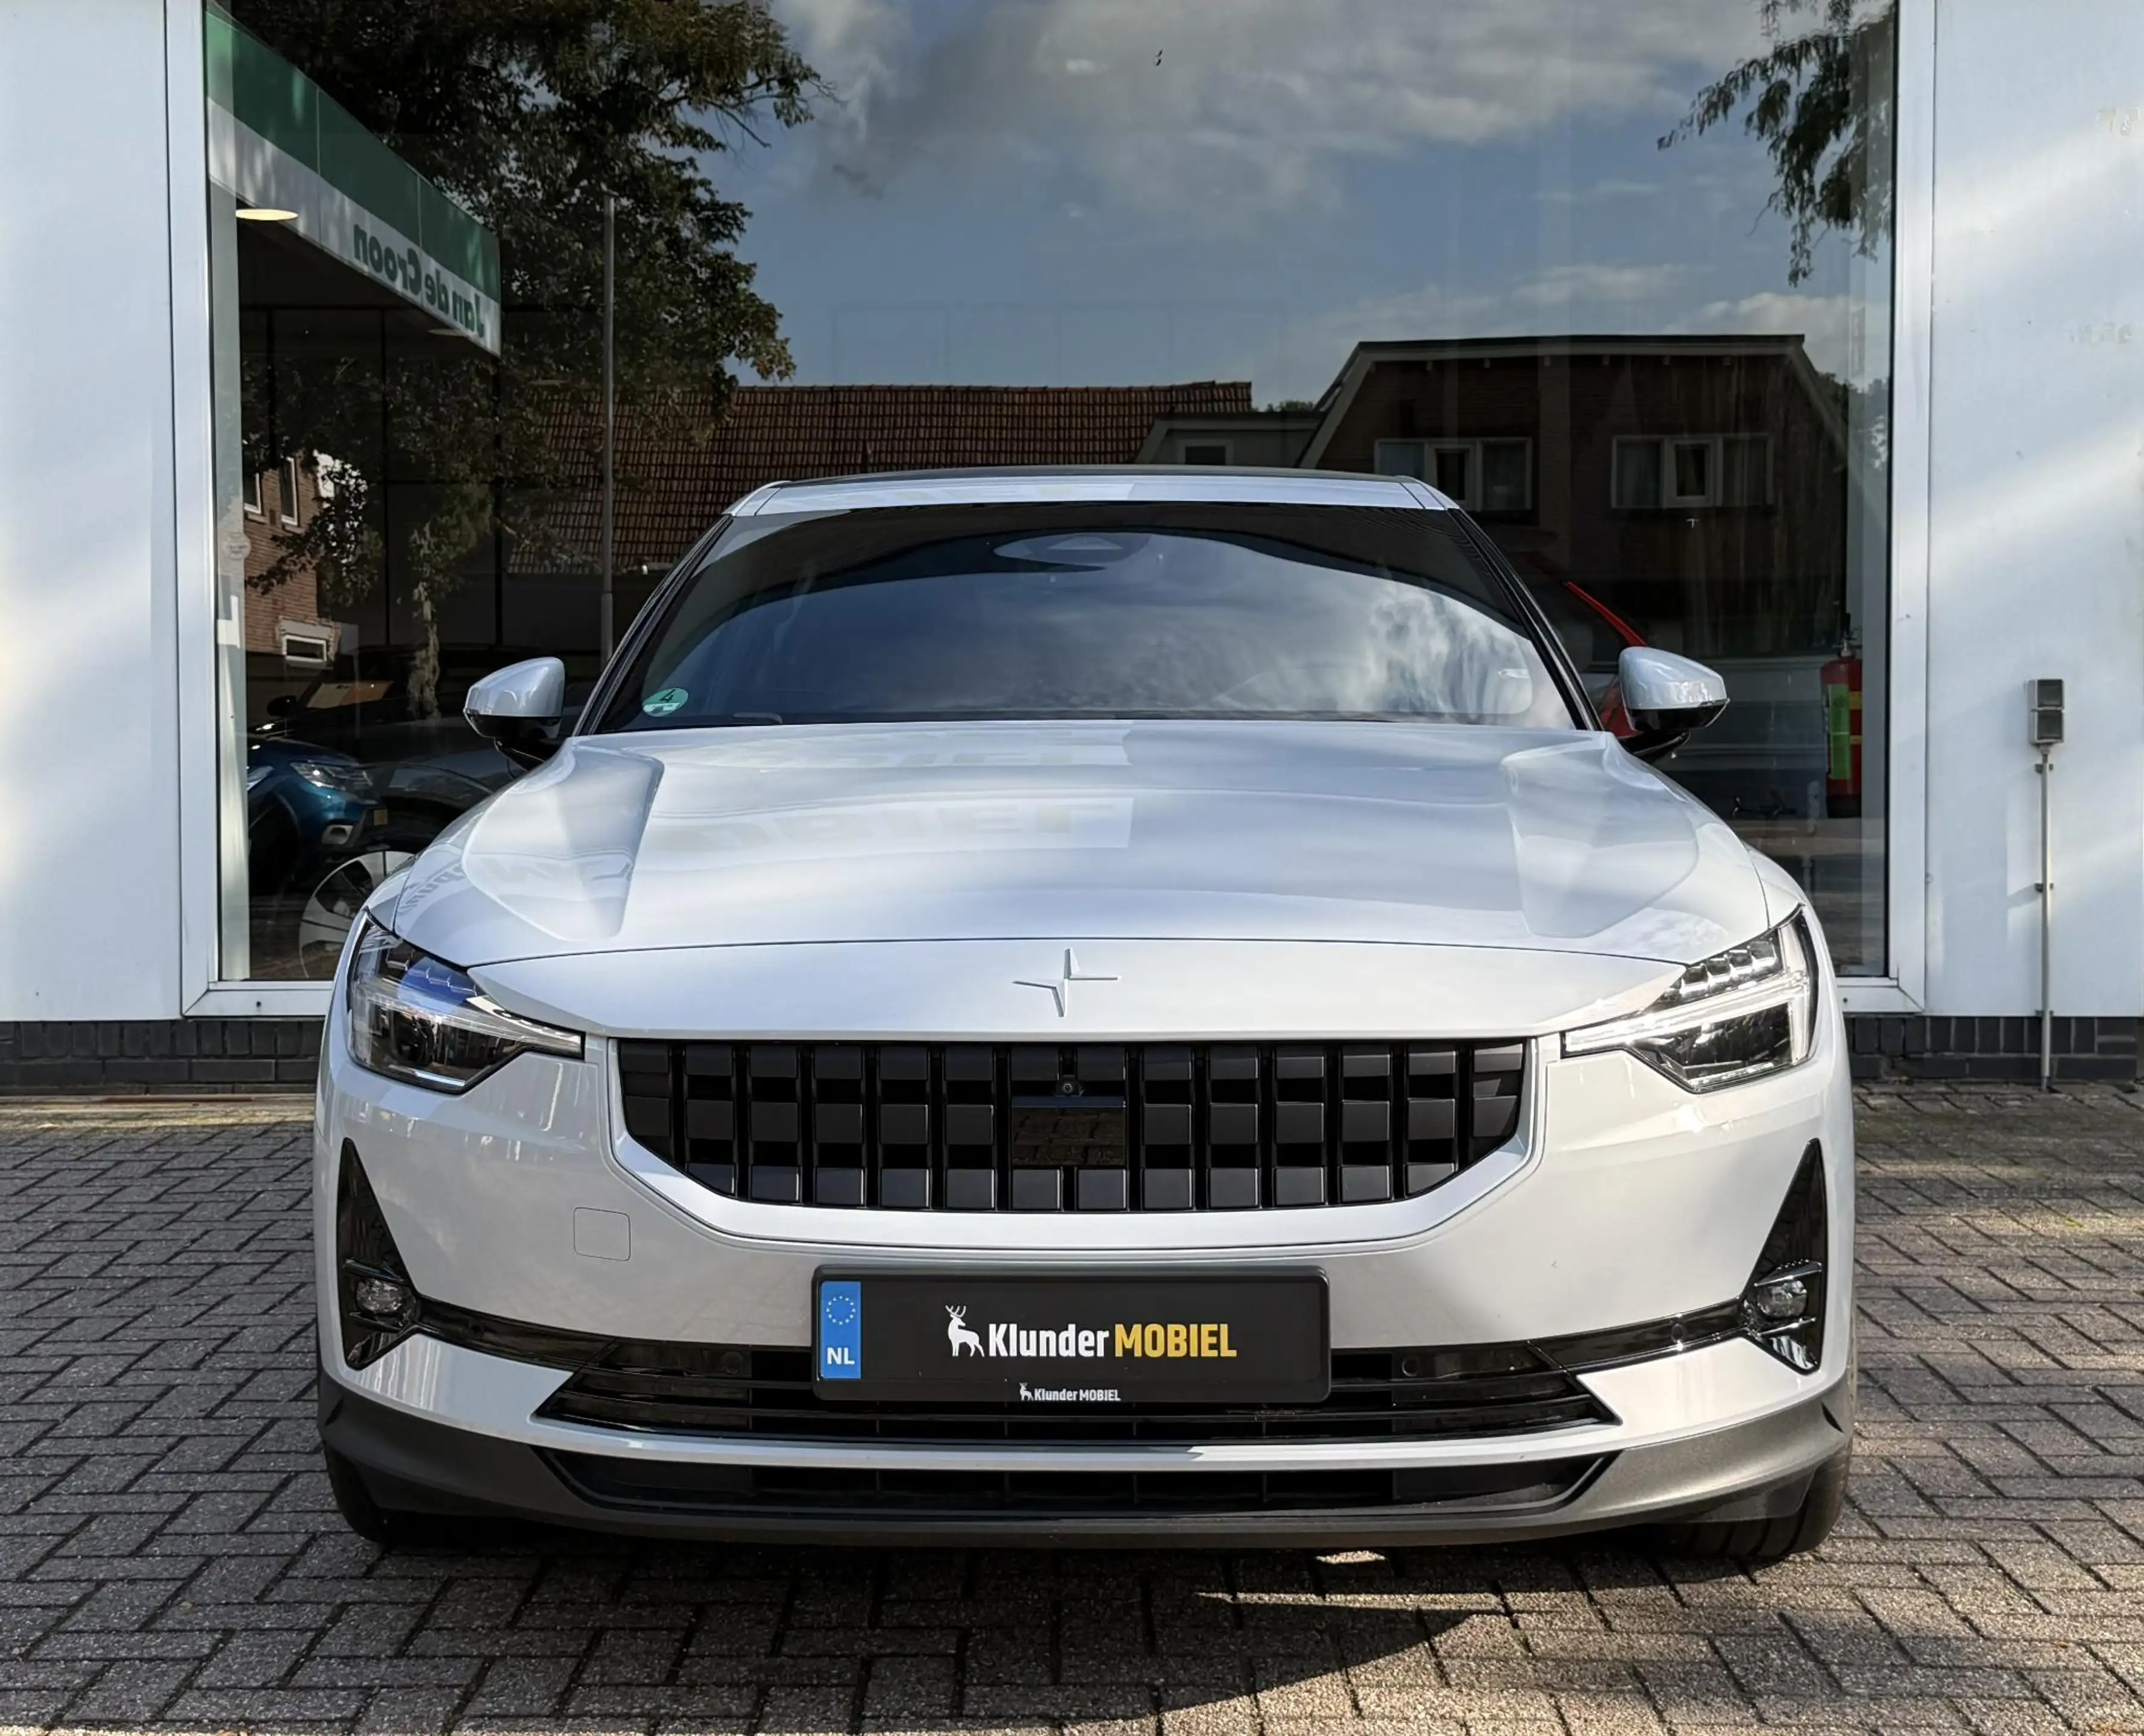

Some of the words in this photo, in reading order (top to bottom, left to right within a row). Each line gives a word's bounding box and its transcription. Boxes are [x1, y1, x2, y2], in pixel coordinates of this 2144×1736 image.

[659, 688, 676, 703] 4
[989, 1323, 1109, 1357] Klunder
[1114, 1323, 1237, 1357] MOBIEL
[826, 1347, 855, 1365] NL
[1034, 1388, 1078, 1401] Klunder
[1079, 1389, 1122, 1401] MOBIEL
